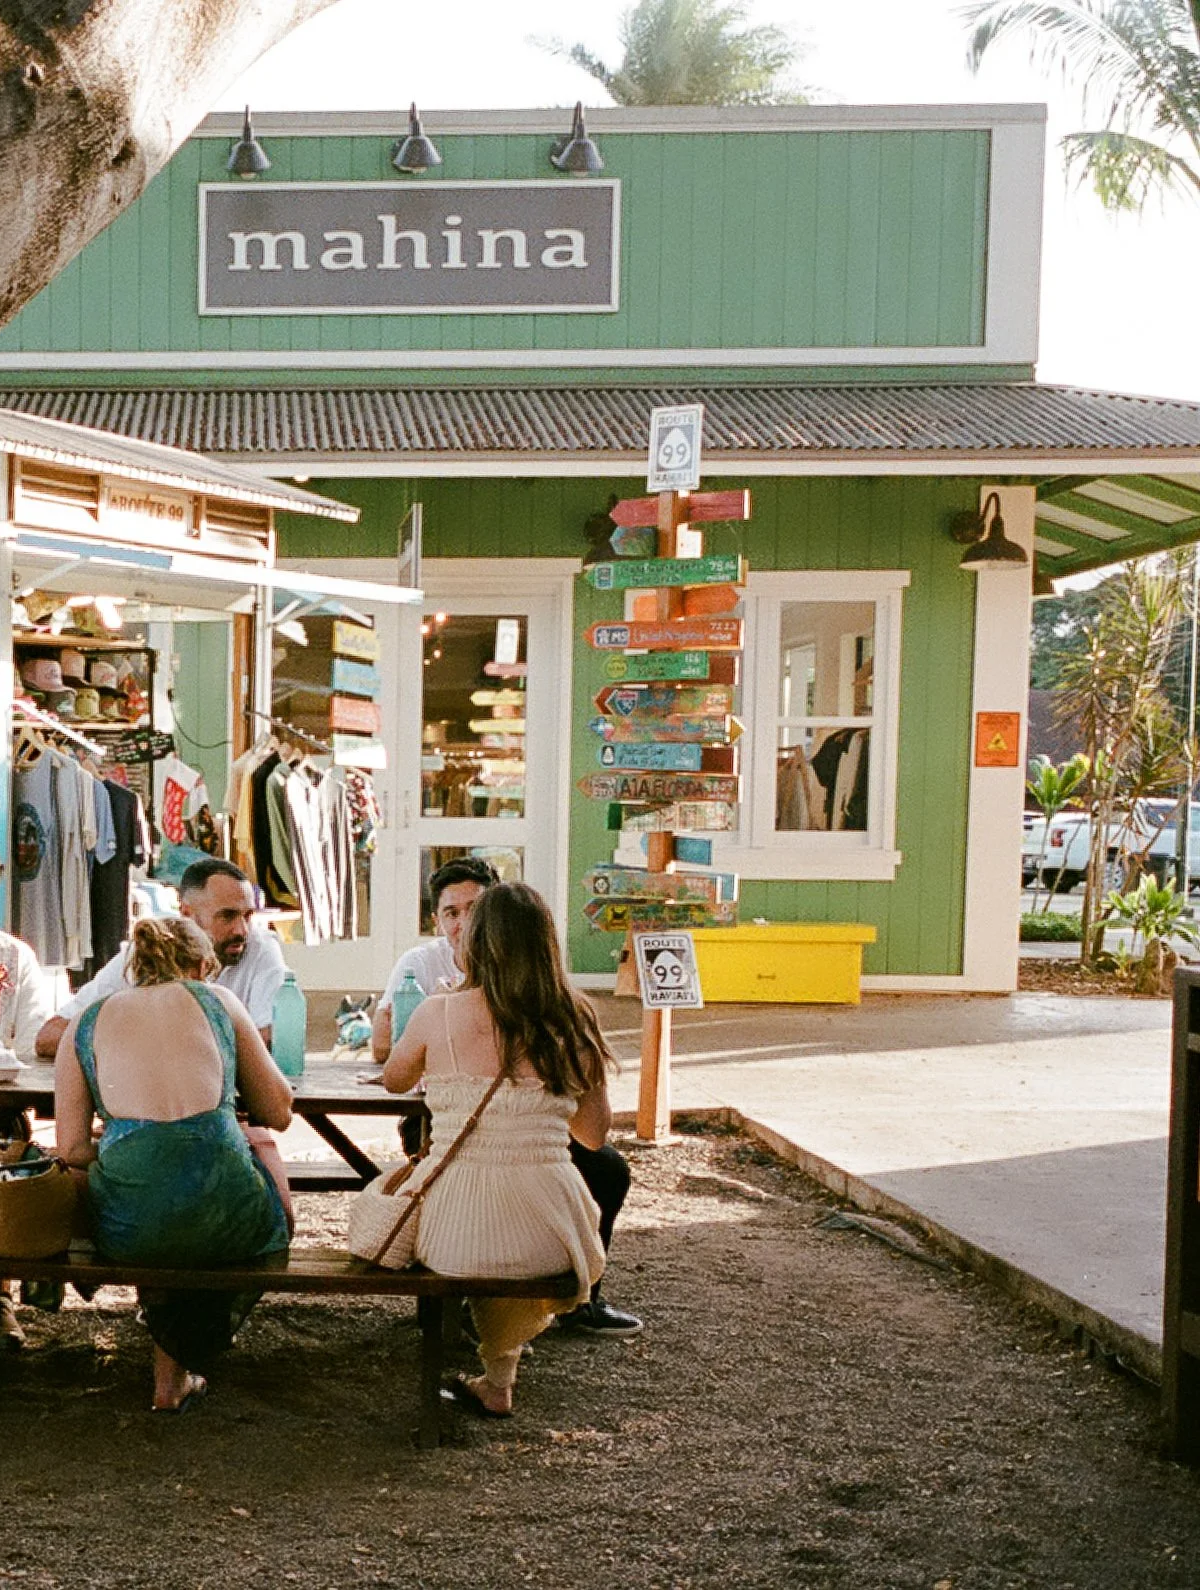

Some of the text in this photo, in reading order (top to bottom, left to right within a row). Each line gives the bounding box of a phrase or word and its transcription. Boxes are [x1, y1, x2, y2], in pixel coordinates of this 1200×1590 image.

[227, 213, 589, 271] mahina
[662, 443, 688, 463] 99
[643, 939, 685, 948] ROUTE
[654, 964, 684, 983] 99
